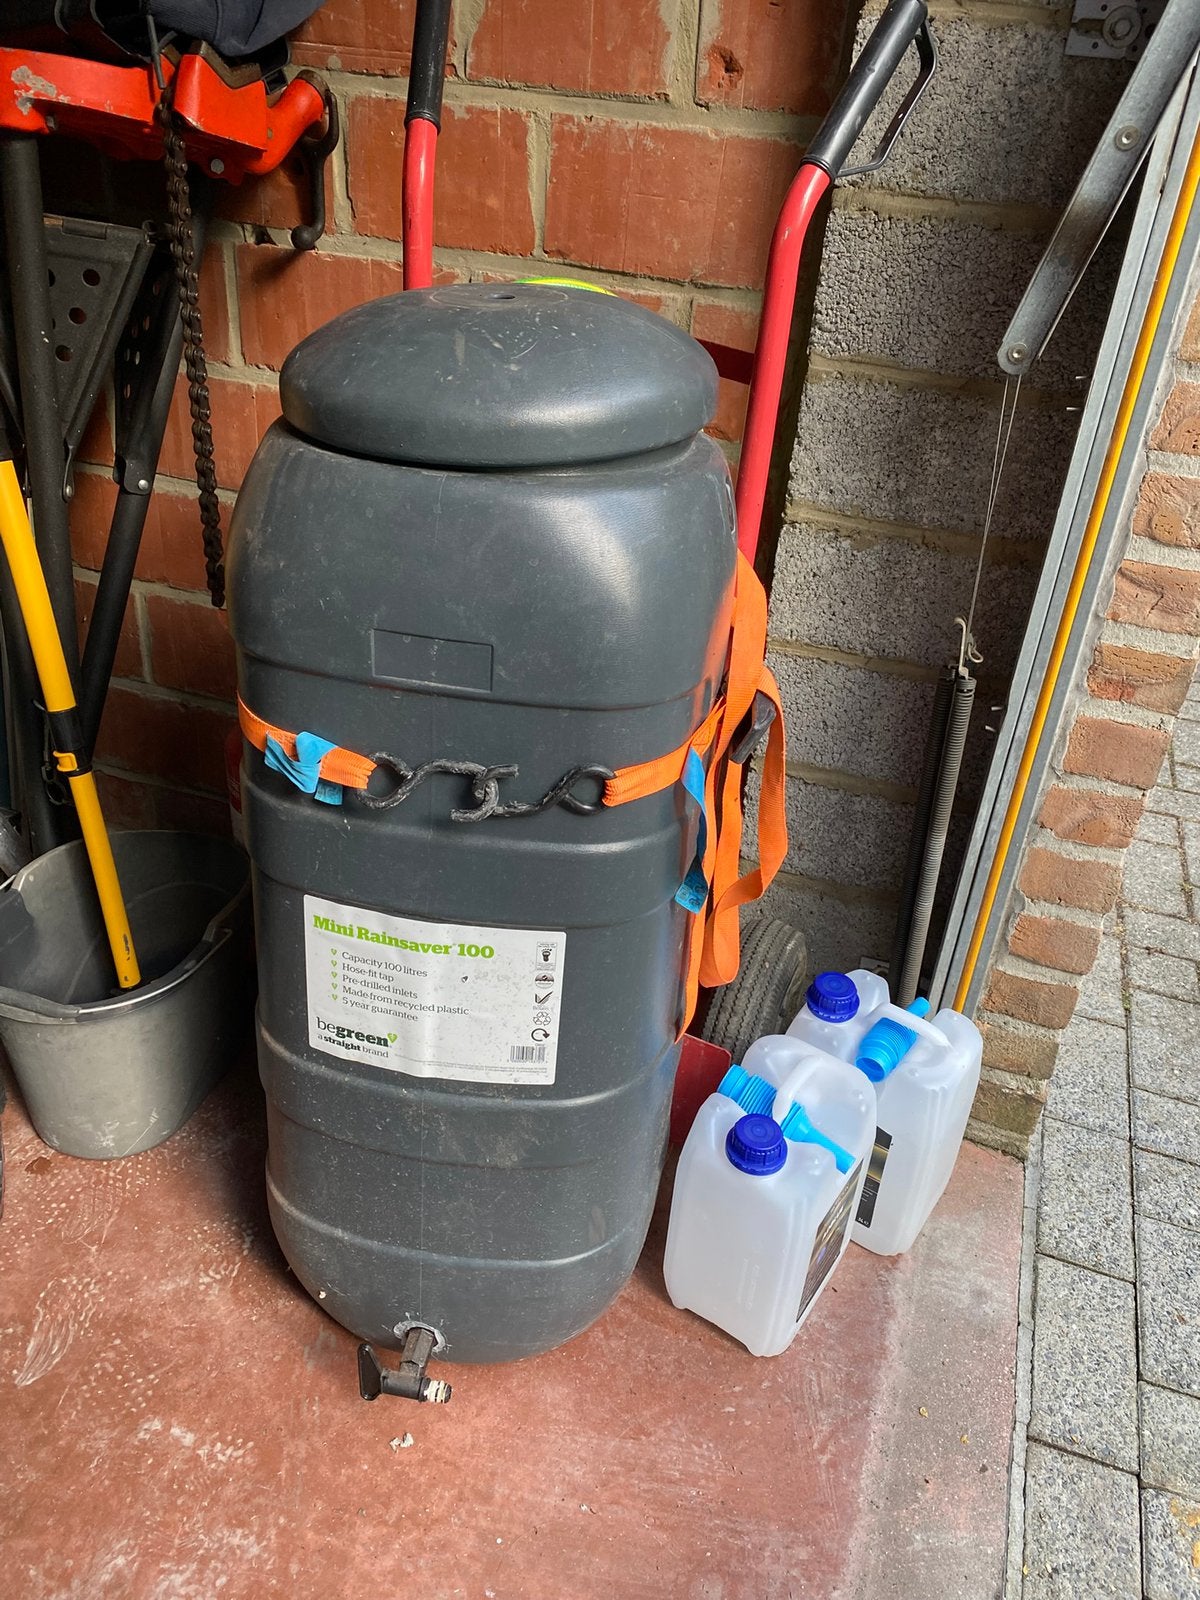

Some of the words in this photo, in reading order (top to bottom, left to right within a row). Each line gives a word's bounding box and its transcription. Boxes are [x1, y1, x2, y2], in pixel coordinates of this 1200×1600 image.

[313, 914, 355, 937] Mini
[356, 926, 452, 954] Rainsaver
[457, 943, 495, 959] 100
[341, 951, 382, 968] Capacity
[384, 961, 402, 972] 100
[403, 965, 428, 977] litres
[342, 963, 377, 978] Hose-fit
[379, 972, 394, 982] tap
[342, 974, 391, 992] Pre-drilled
[392, 986, 418, 999] inlets
[342, 985, 369, 998] Made
[369, 994, 392, 1004] from
[394, 999, 435, 1011] recycled
[436, 1004, 470, 1015] plastic
[342, 996, 348, 1005] 5
[349, 999, 369, 1010] year
[371, 1005, 418, 1022] guarantee
[316, 1016, 389, 1047] begreen
[323, 1036, 361, 1051] straight
[362, 1045, 389, 1058] brand
